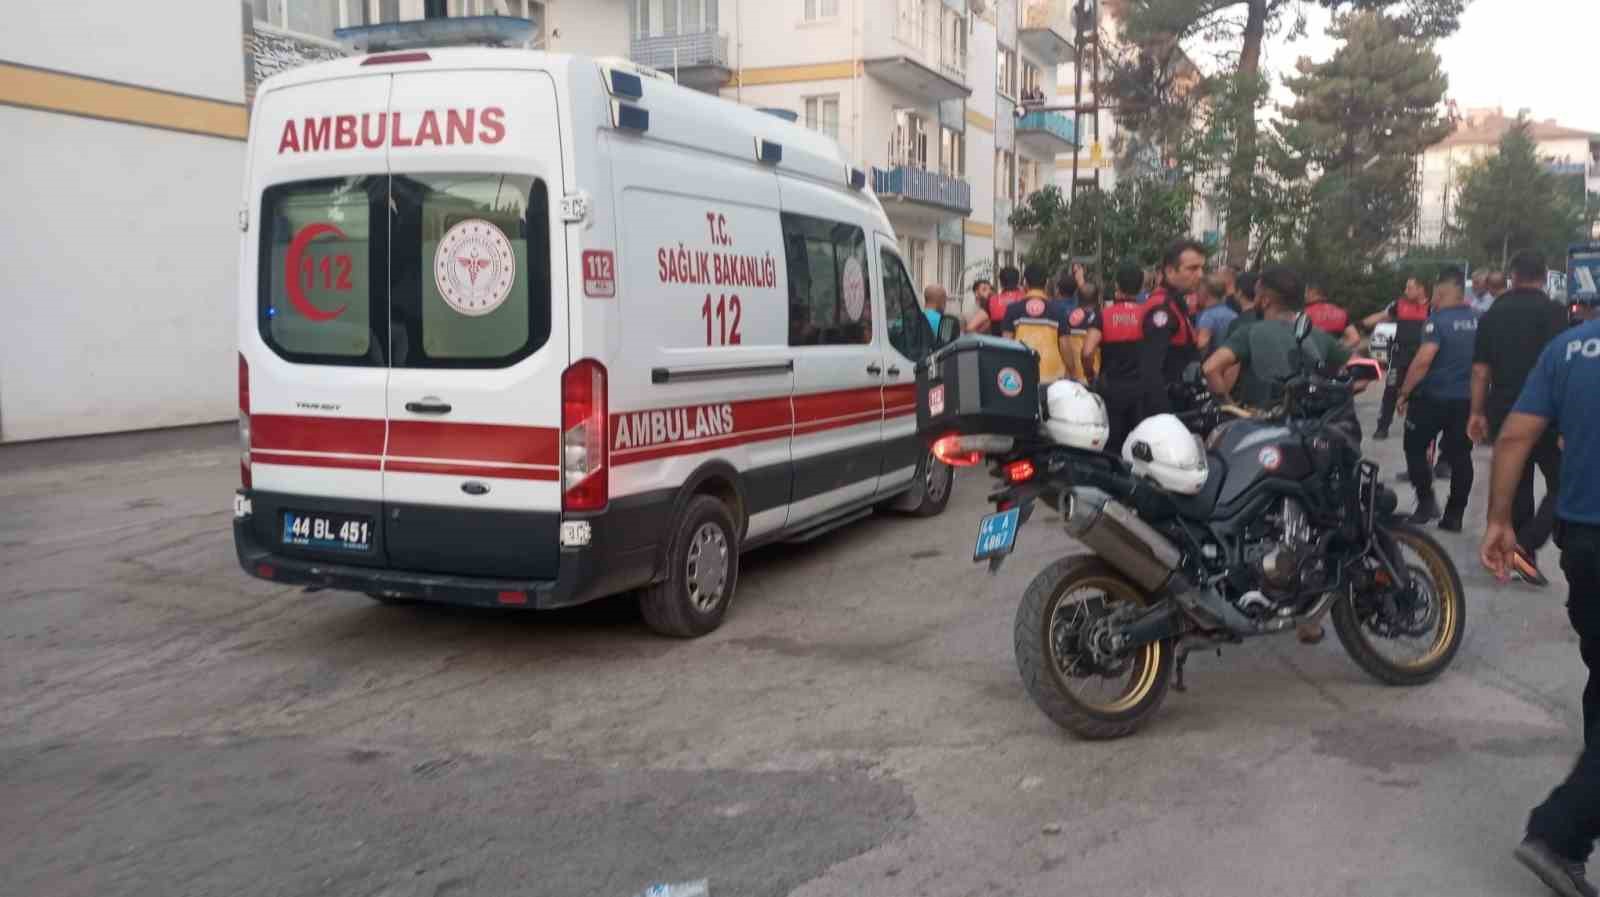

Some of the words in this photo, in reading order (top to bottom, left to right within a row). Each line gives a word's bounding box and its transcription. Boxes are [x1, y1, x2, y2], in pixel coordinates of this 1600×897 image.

[278, 106, 507, 154] AMBULANS
[706, 212, 733, 246] T.C.
[301, 255, 353, 291] 112
[588, 255, 611, 279] 112
[658, 243, 710, 285] SAĞLIK
[713, 253, 777, 289] BAKANLIĞI
[702, 293, 742, 347] 112
[615, 404, 734, 449] AMBULANS
[292, 517, 311, 538] 44
[313, 518, 335, 539] BL
[340, 521, 368, 544] 451
